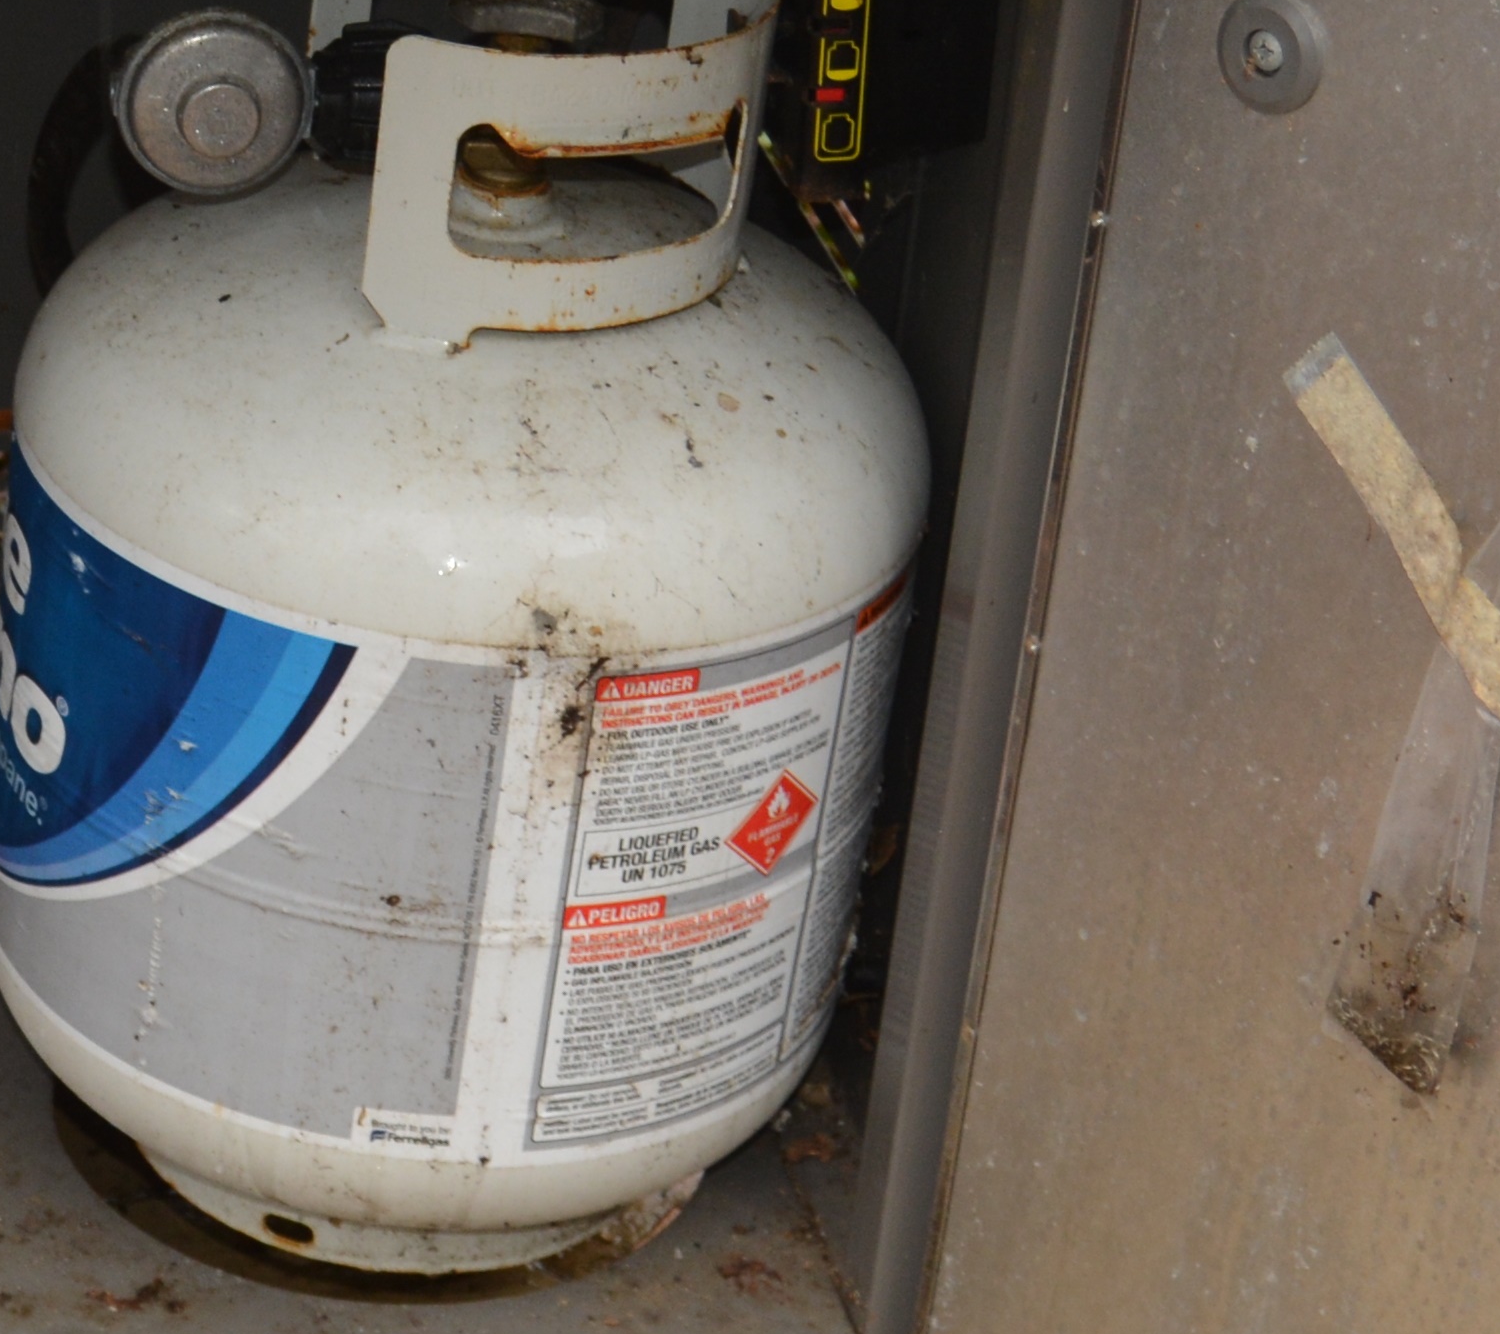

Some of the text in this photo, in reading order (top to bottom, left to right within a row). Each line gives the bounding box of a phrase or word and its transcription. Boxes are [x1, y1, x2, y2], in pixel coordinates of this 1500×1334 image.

[622, 675, 694, 697] DANGER
[618, 827, 699, 852] LIQUEFIED
[588, 837, 720, 870] PETROLEUM GAS
[765, 848, 775, 864] 2
[621, 862, 686, 883] UN 1075
[588, 901, 660, 924] PELIGRO
